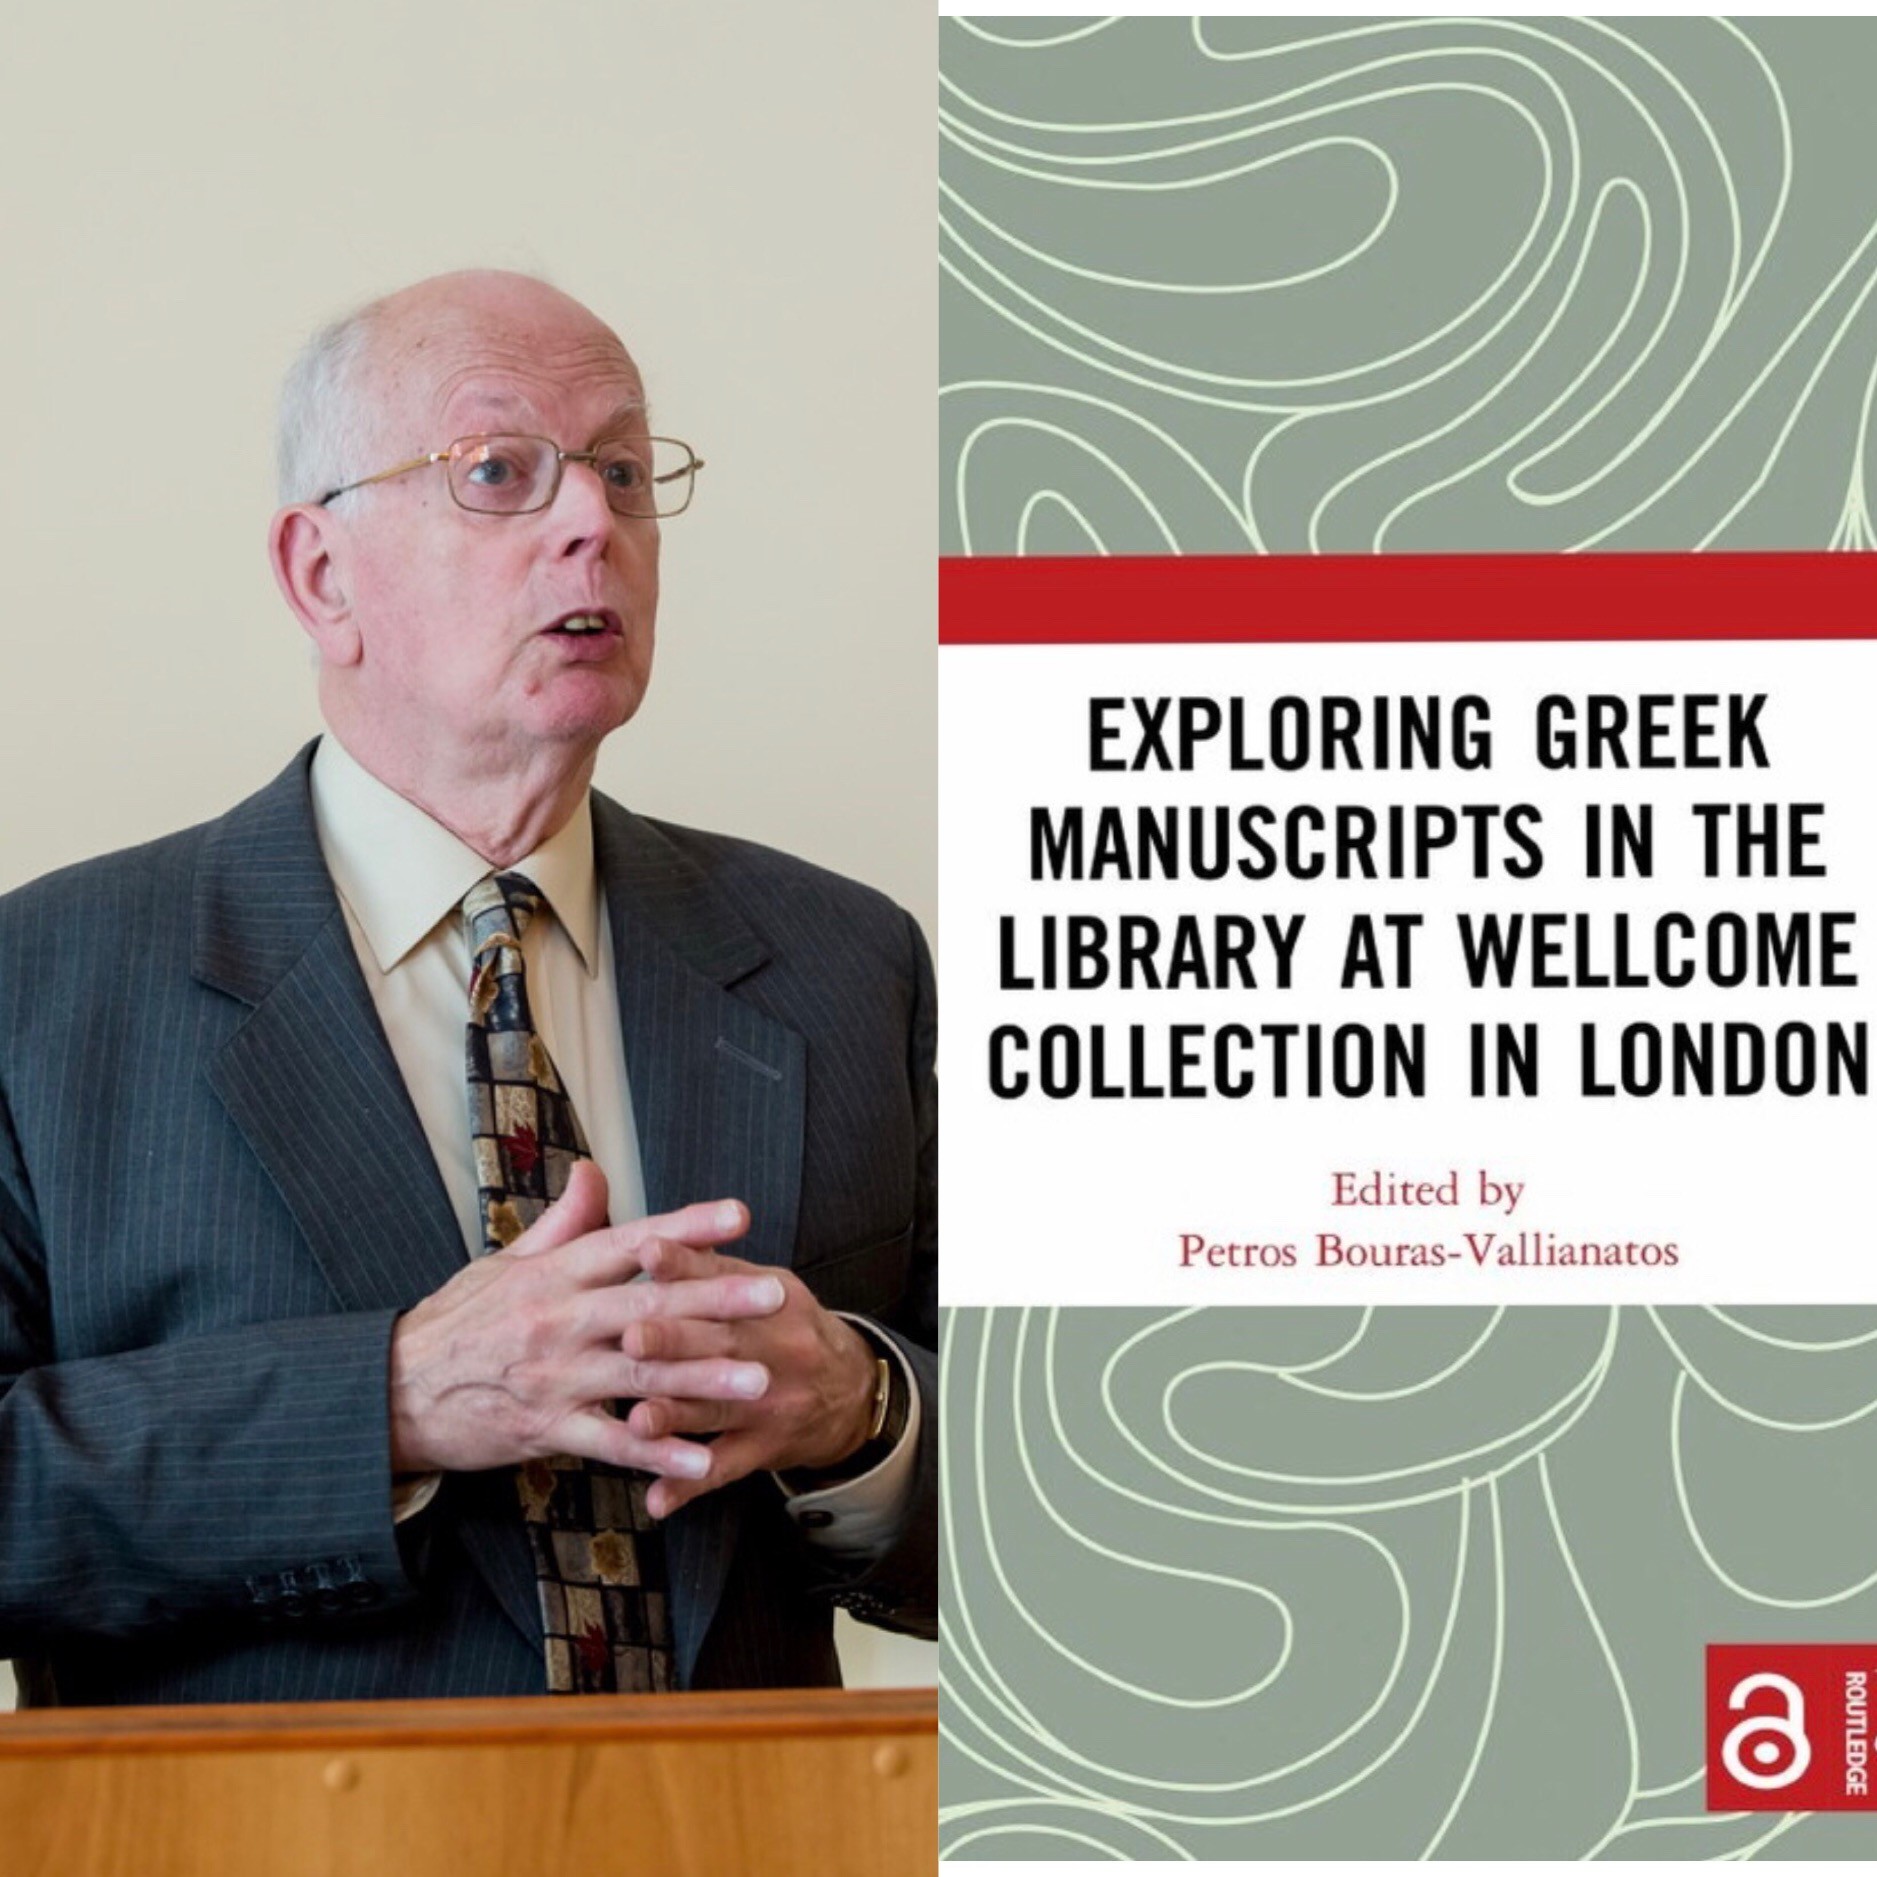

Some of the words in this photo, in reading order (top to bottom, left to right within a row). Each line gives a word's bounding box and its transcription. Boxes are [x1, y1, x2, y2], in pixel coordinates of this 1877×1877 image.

[1089, 694, 1492, 772] EXPLORING
[1536, 693, 1771, 771] GREEK
[1030, 803, 1544, 881] MANUSCRIPTS
[1585, 803, 1653, 879] IN
[1691, 802, 1827, 878] THE
[999, 914, 1306, 991] LIBRARY
[1340, 913, 1424, 989] AT
[1456, 911, 1858, 989] WELLCOME
[988, 1022, 1426, 1100] COLLECTION
[1470, 1022, 1538, 1098] IN
[1581, 1021, 1868, 1098] LONDON
[1332, 1170, 1459, 1207] Edited
[1478, 1170, 1525, 1215] by
[1179, 1233, 1298, 1268] Petros
[1316, 1231, 1680, 1268] Bouras-Vallianatos
[1845, 1671, 1868, 1796] ROUTLEDGE
